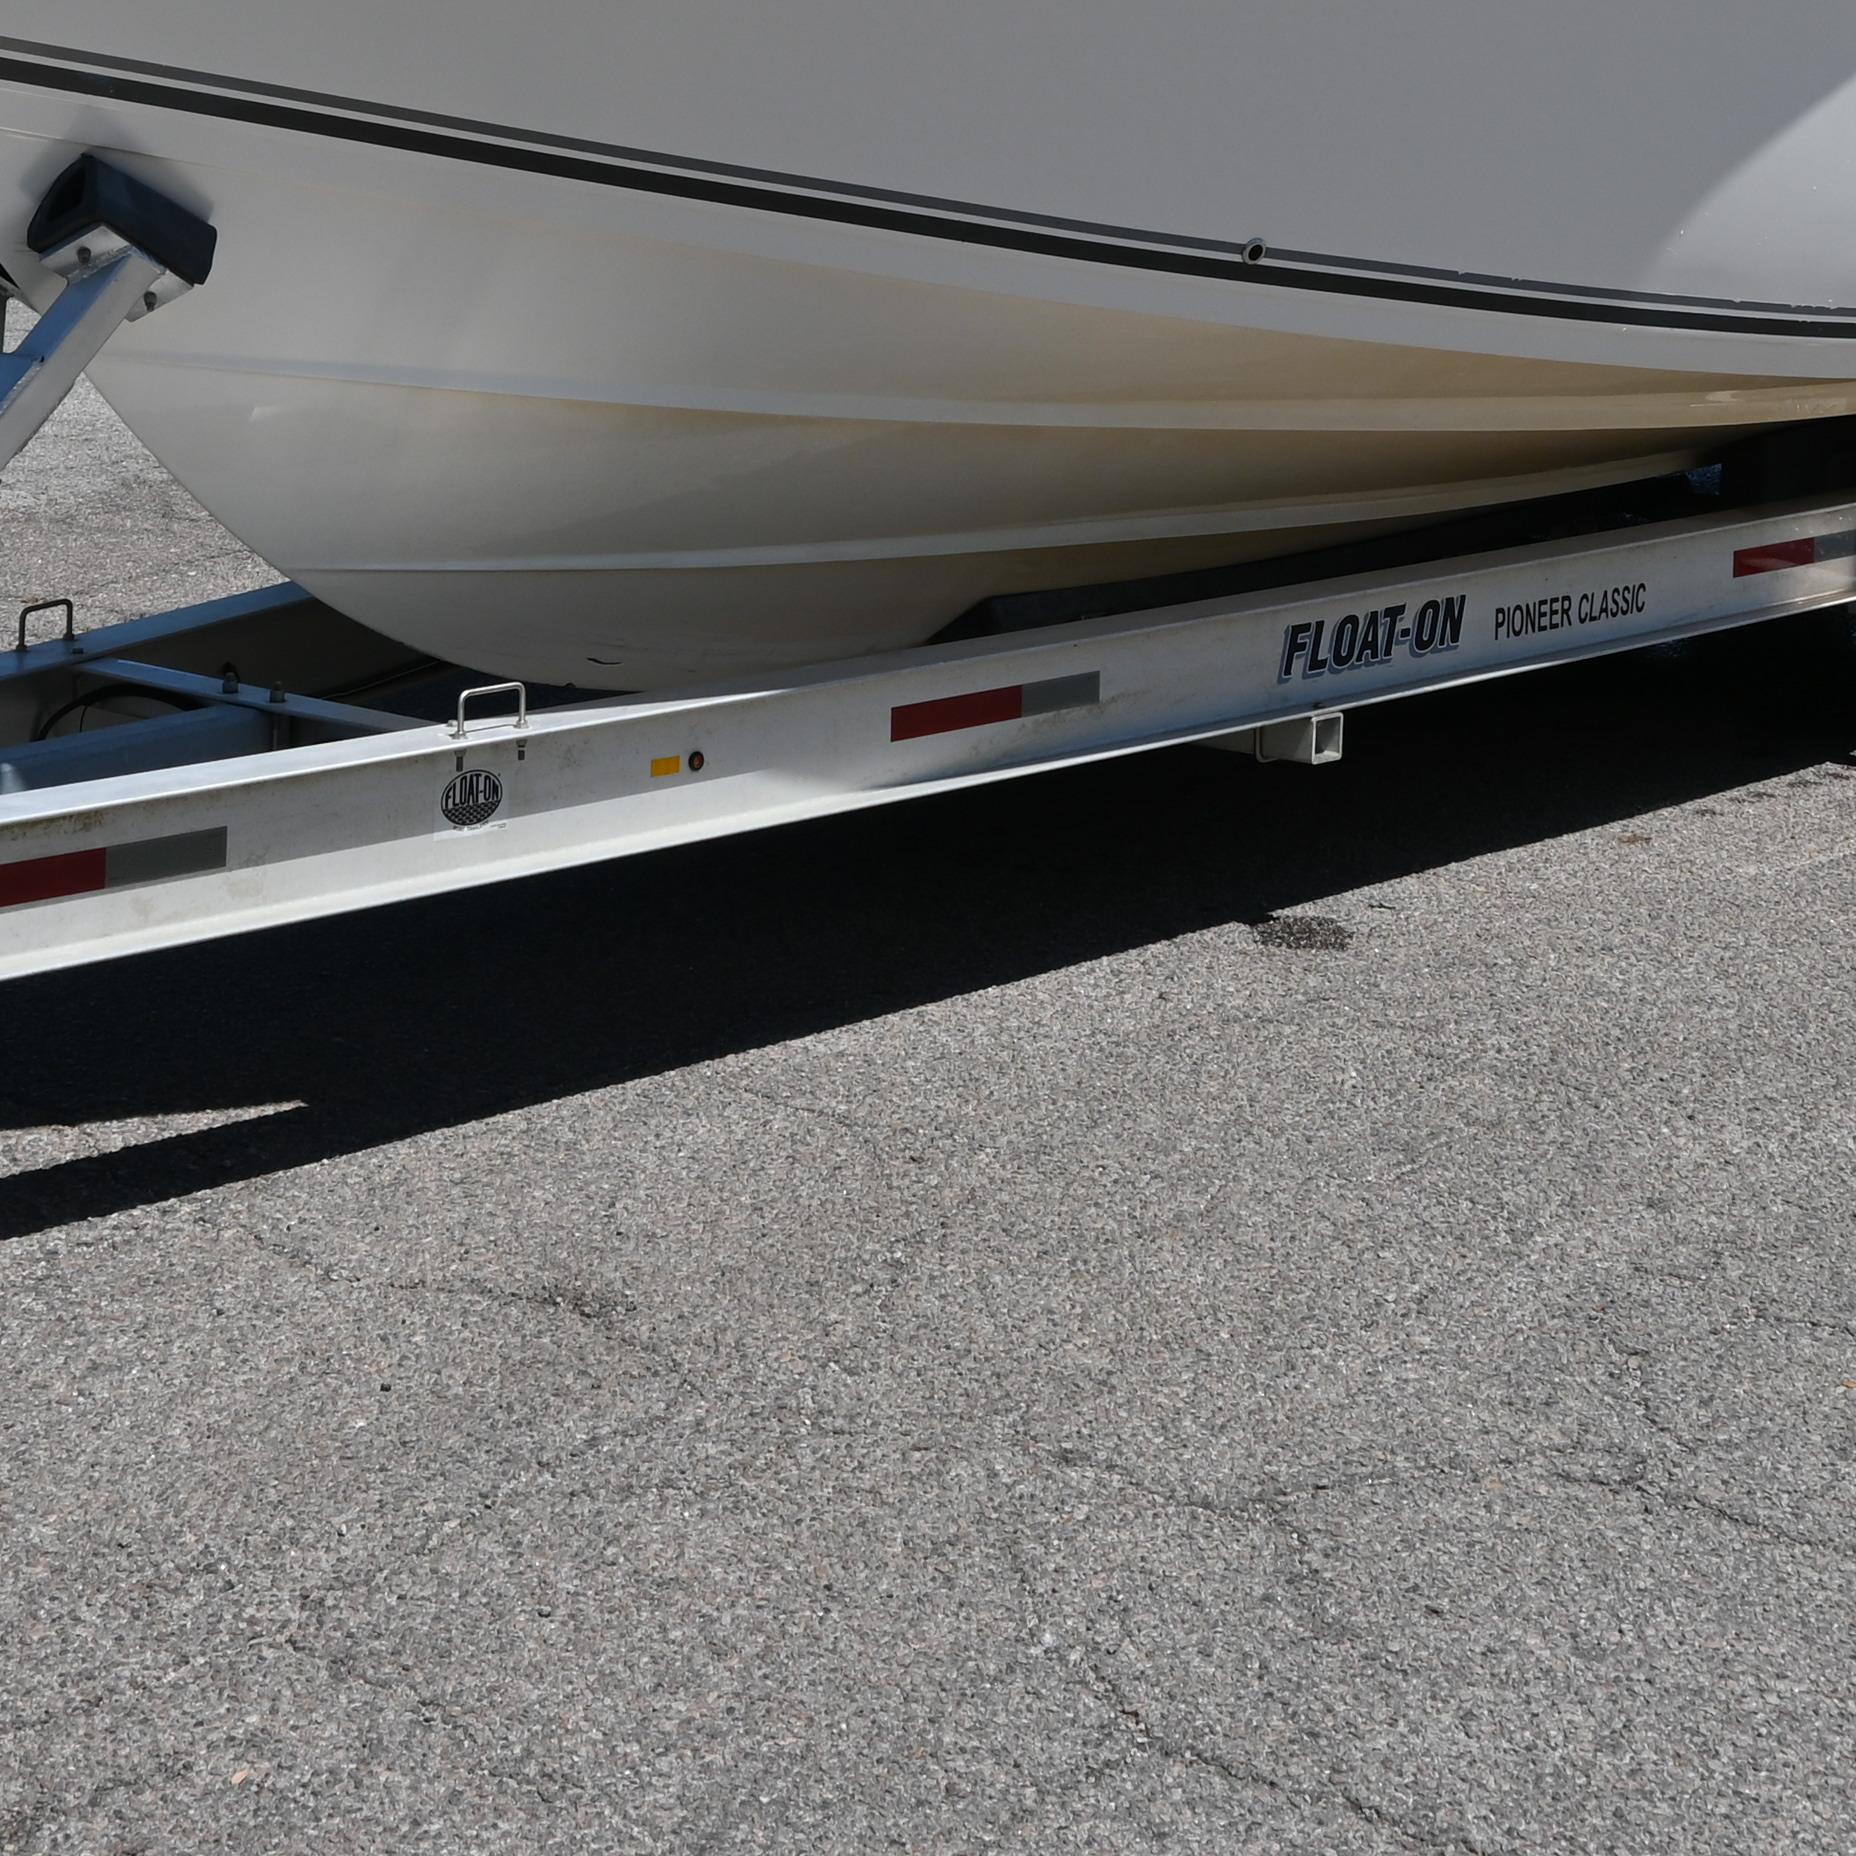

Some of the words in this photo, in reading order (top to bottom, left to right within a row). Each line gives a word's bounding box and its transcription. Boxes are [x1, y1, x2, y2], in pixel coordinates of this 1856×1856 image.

[1280, 594, 1467, 680] FLOAT-ON
[1494, 594, 1573, 641] PIONEER
[1577, 582, 1647, 625] CLASSIC
[445, 773, 499, 809] FLOAT-ON
